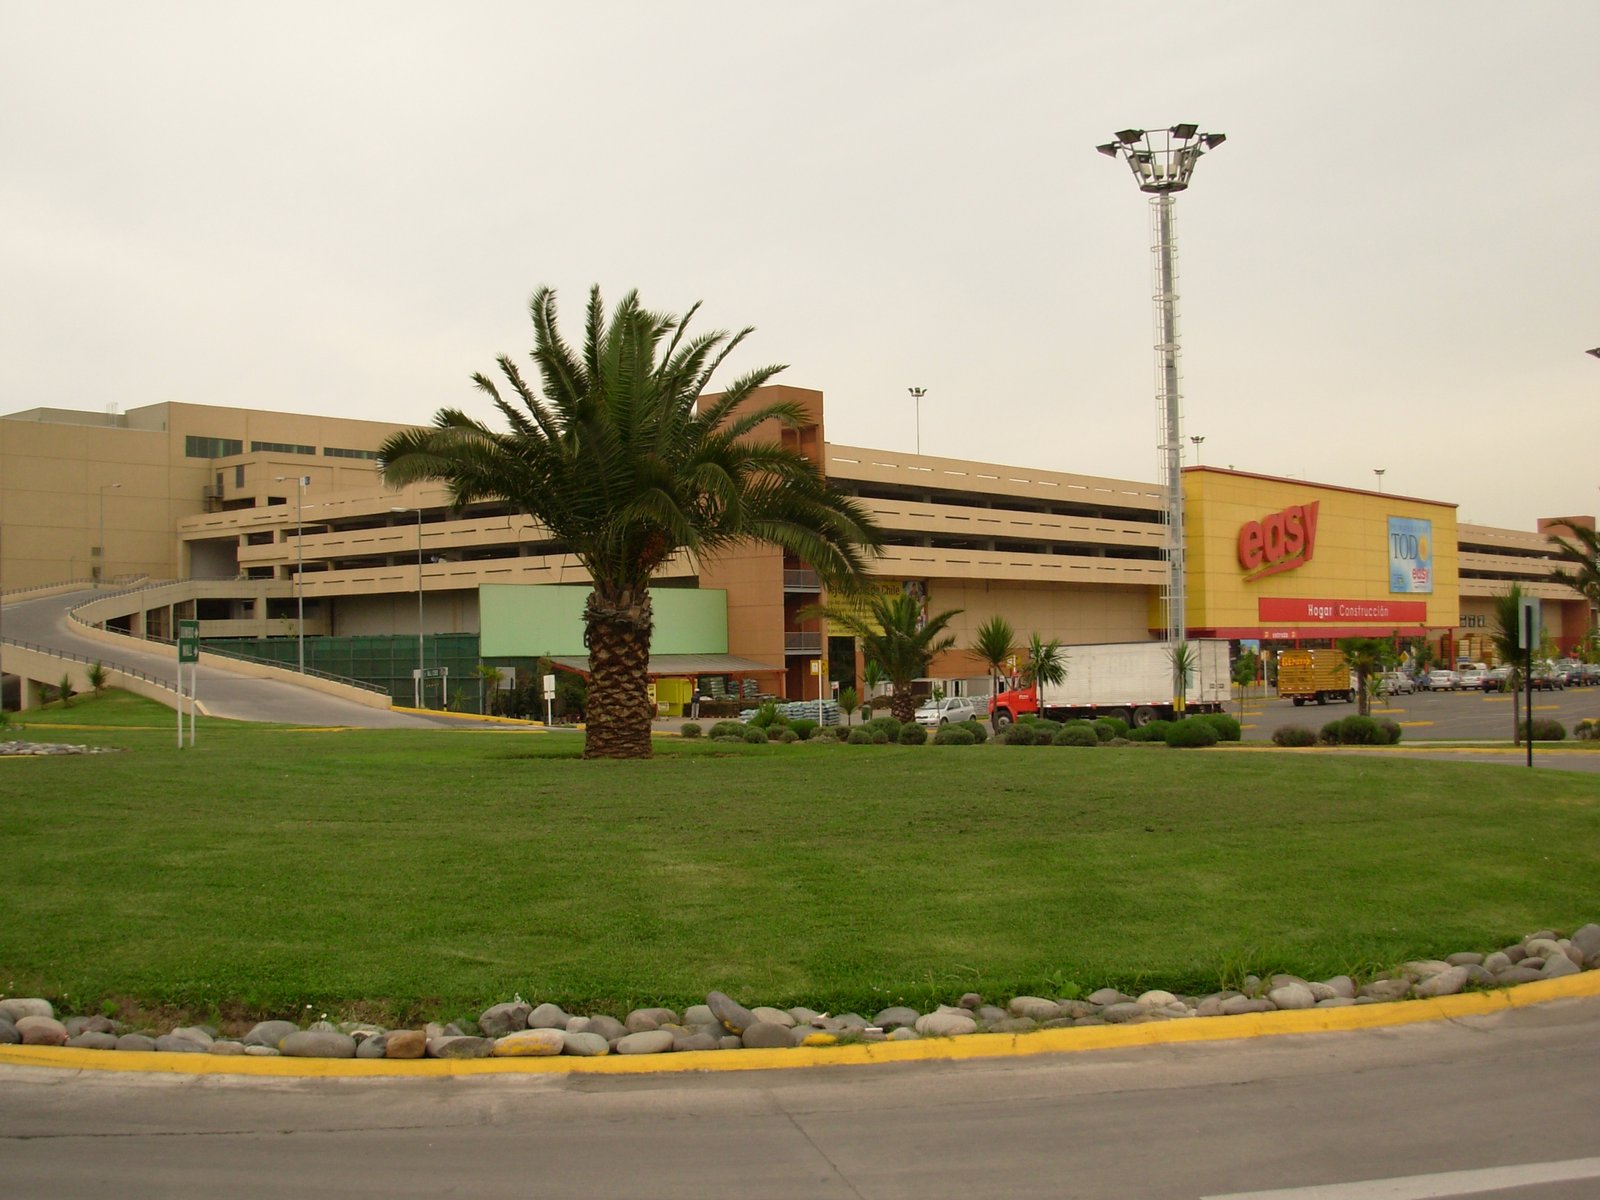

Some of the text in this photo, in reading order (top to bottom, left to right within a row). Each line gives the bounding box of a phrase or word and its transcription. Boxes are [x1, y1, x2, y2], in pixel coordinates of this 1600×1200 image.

[1238, 500, 1320, 570] easy
[881, 585, 900, 596] Chile
[1308, 604, 1332, 619] Hogar
[1339, 604, 1389, 617] Construcción
